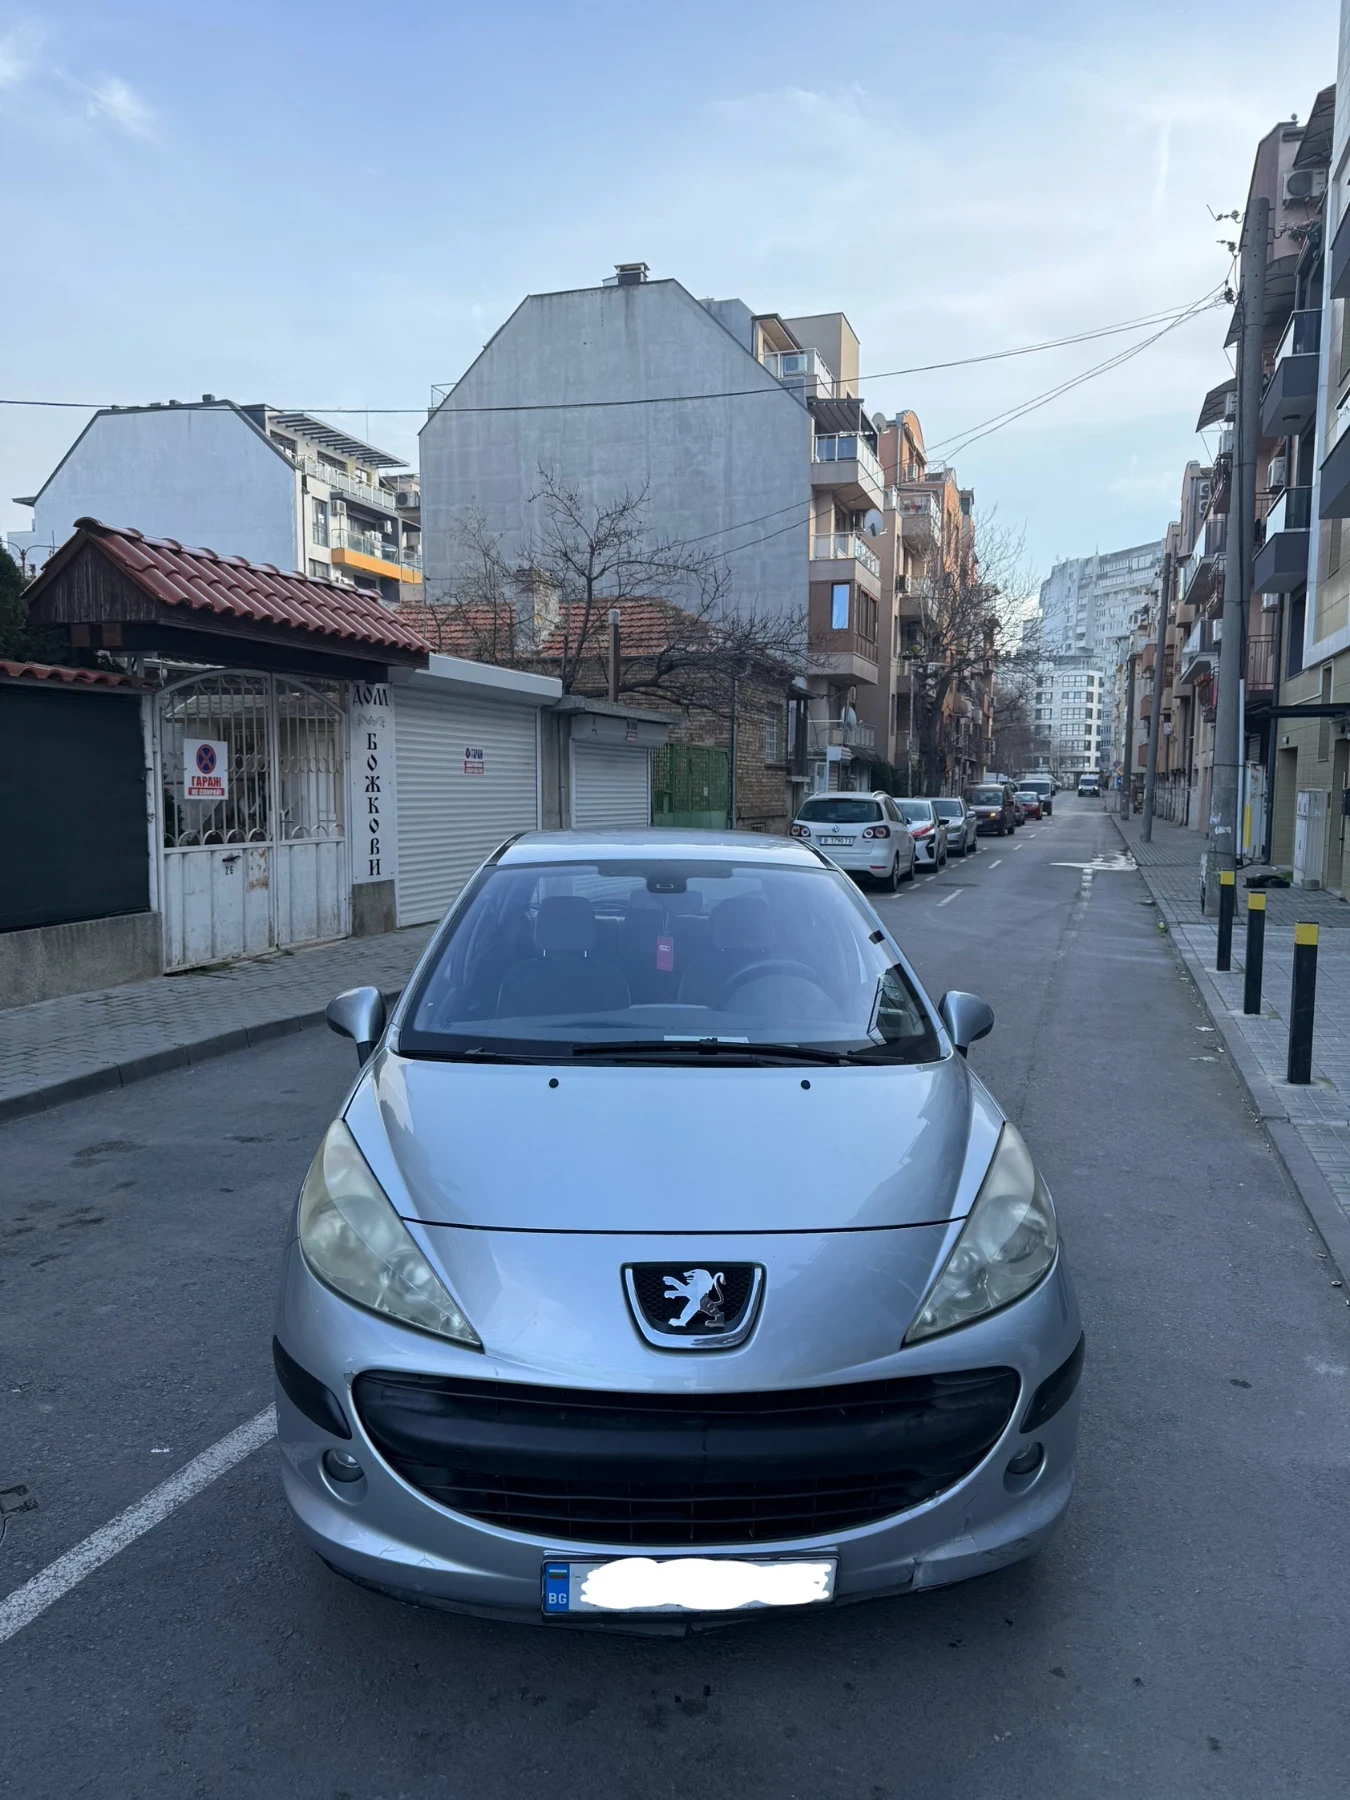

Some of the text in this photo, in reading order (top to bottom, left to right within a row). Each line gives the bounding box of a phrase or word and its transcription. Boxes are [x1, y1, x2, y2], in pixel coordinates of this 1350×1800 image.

[352, 685, 389, 708] ДОМ
[191, 775, 222, 787] ГАРАЖ
[365, 733, 381, 876] БОЖКОВИ
[548, 1592, 567, 1604] BG
